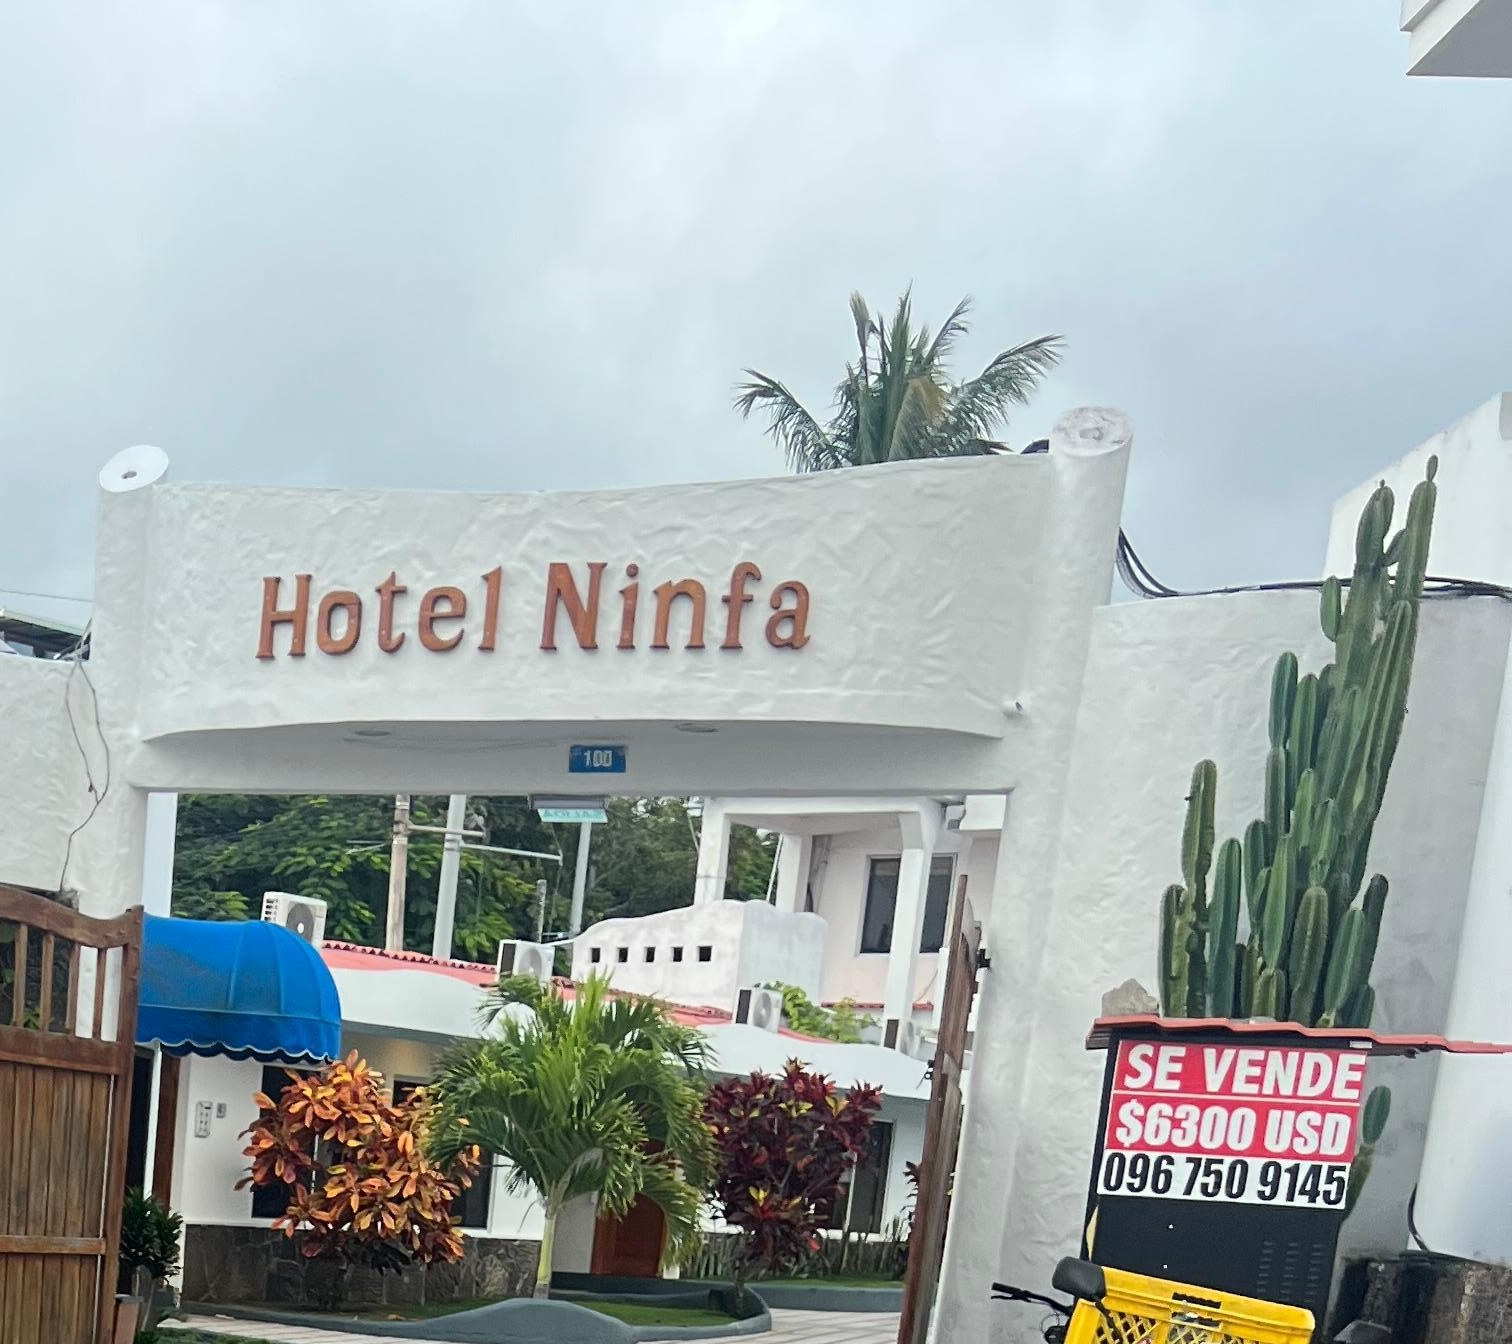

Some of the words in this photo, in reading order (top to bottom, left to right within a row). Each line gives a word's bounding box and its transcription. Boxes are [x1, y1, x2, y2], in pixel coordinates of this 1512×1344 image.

[255, 566, 502, 659] Hotel
[539, 561, 811, 651] Ninfa
[1123, 1043, 1186, 1091] SE
[1203, 1047, 1367, 1100] VENDE
[1115, 1099, 1256, 1151] $6300
[1264, 1109, 1351, 1156] USD
[1103, 1152, 1175, 1195] 096
[1183, 1156, 1249, 1199] 750
[1257, 1160, 1347, 1206] 9145
